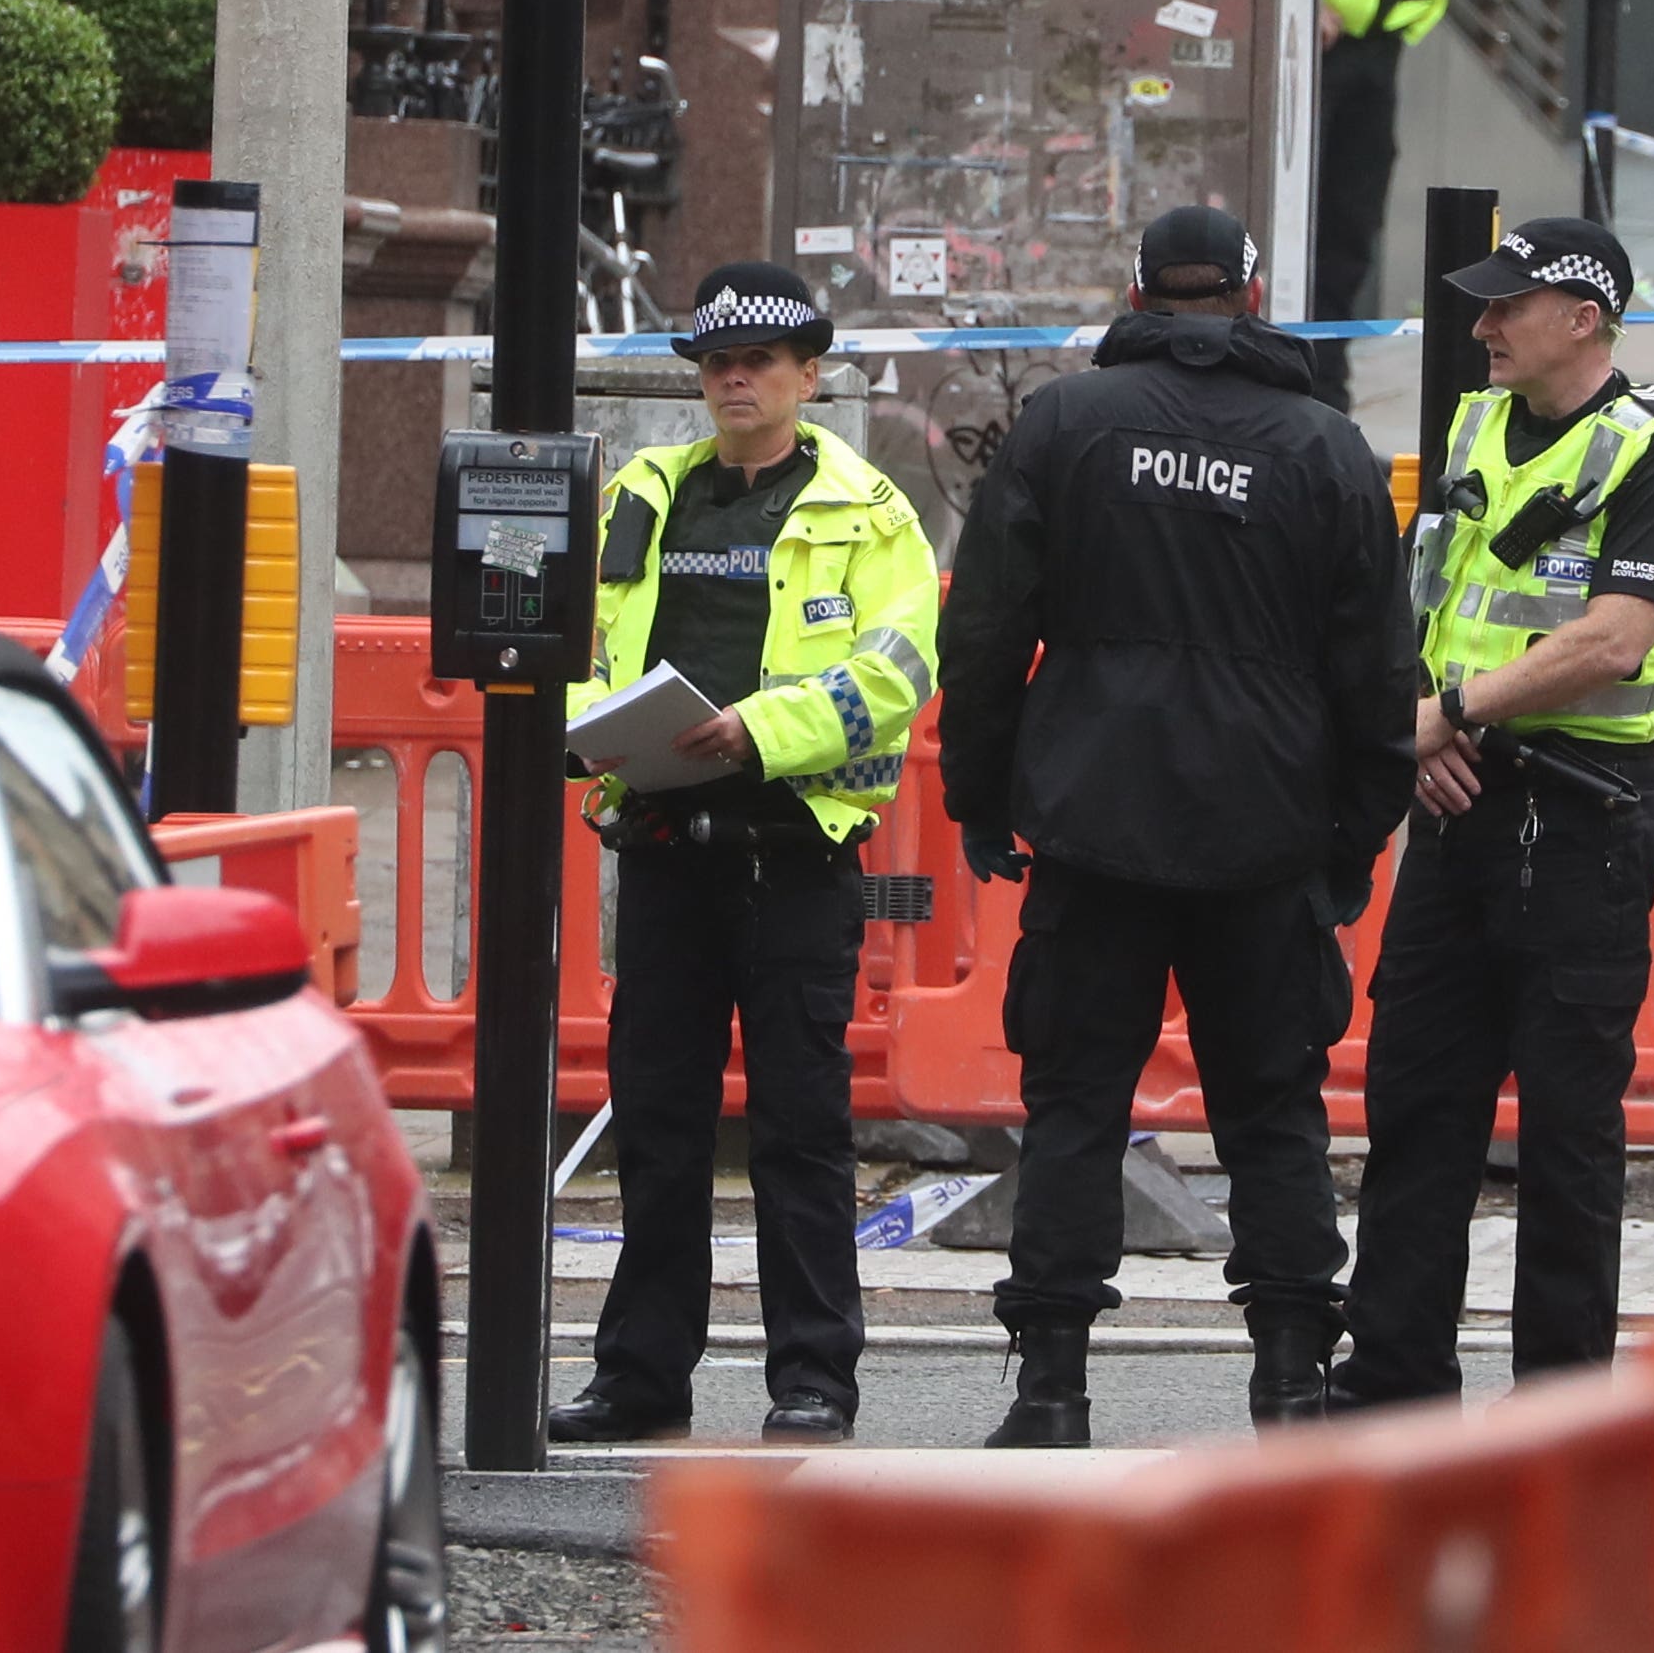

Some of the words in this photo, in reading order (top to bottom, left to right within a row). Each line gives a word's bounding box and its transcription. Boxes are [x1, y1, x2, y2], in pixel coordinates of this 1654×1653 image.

[467, 472, 565, 486] PEDESTRIANS
[1131, 446, 1253, 502] POLICE
[887, 511, 909, 527] 268
[729, 549, 769, 575] POLI
[1538, 558, 1594, 580] POLICE
[806, 598, 851, 621] POLICE
